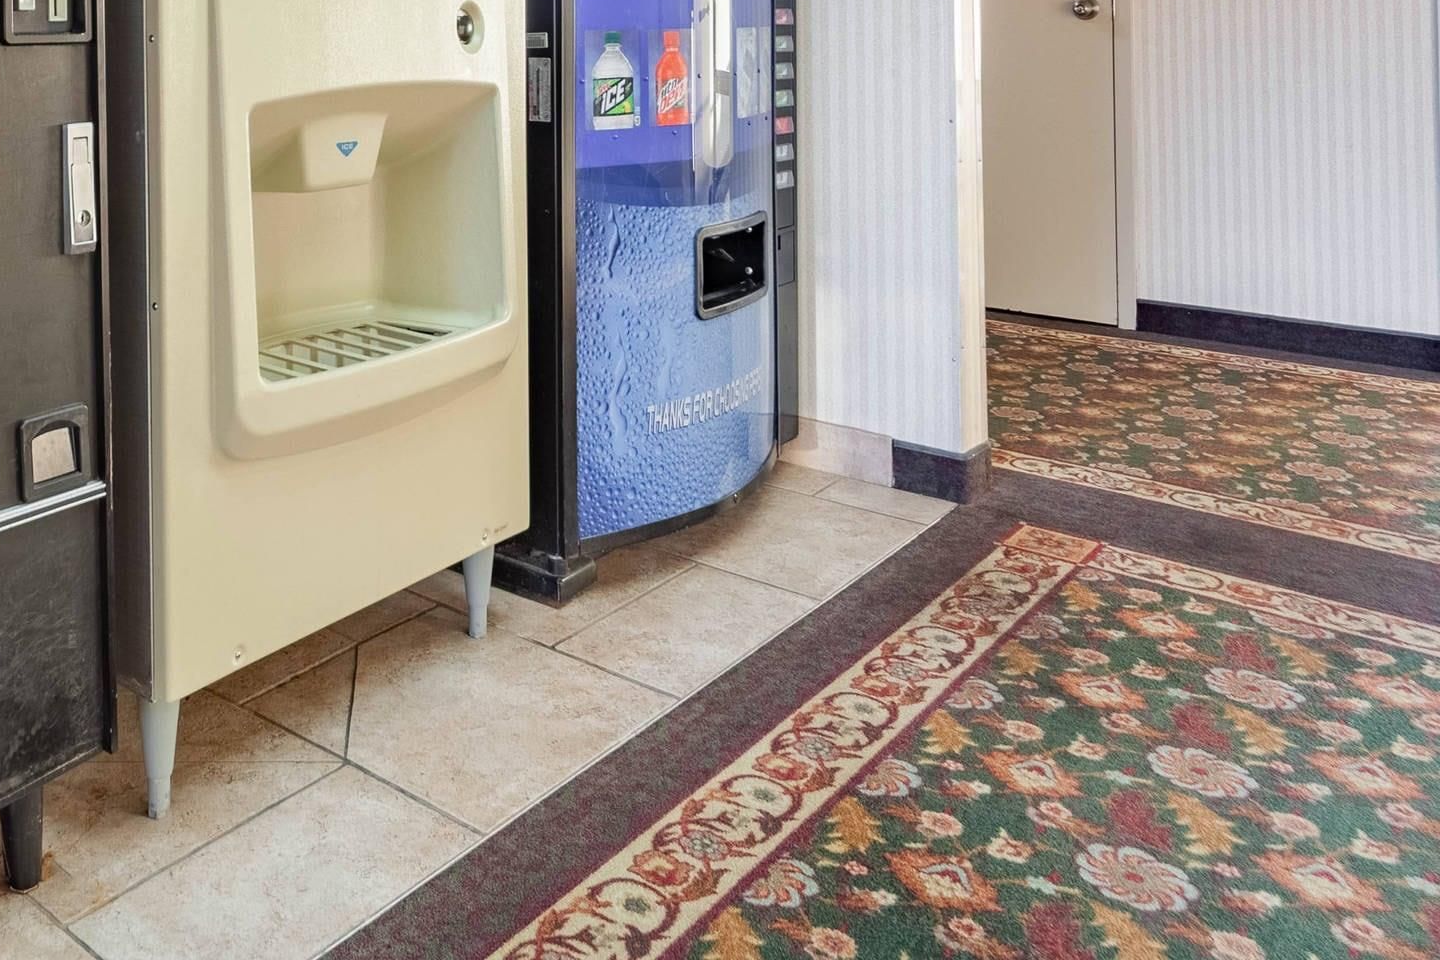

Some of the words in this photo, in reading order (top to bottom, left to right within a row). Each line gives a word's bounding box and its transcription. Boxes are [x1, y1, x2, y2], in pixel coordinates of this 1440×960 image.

[600, 78, 627, 115] ICE
[340, 142, 354, 152] ICE
[647, 396, 692, 435] THANKS
[692, 390, 714, 425] FOR
